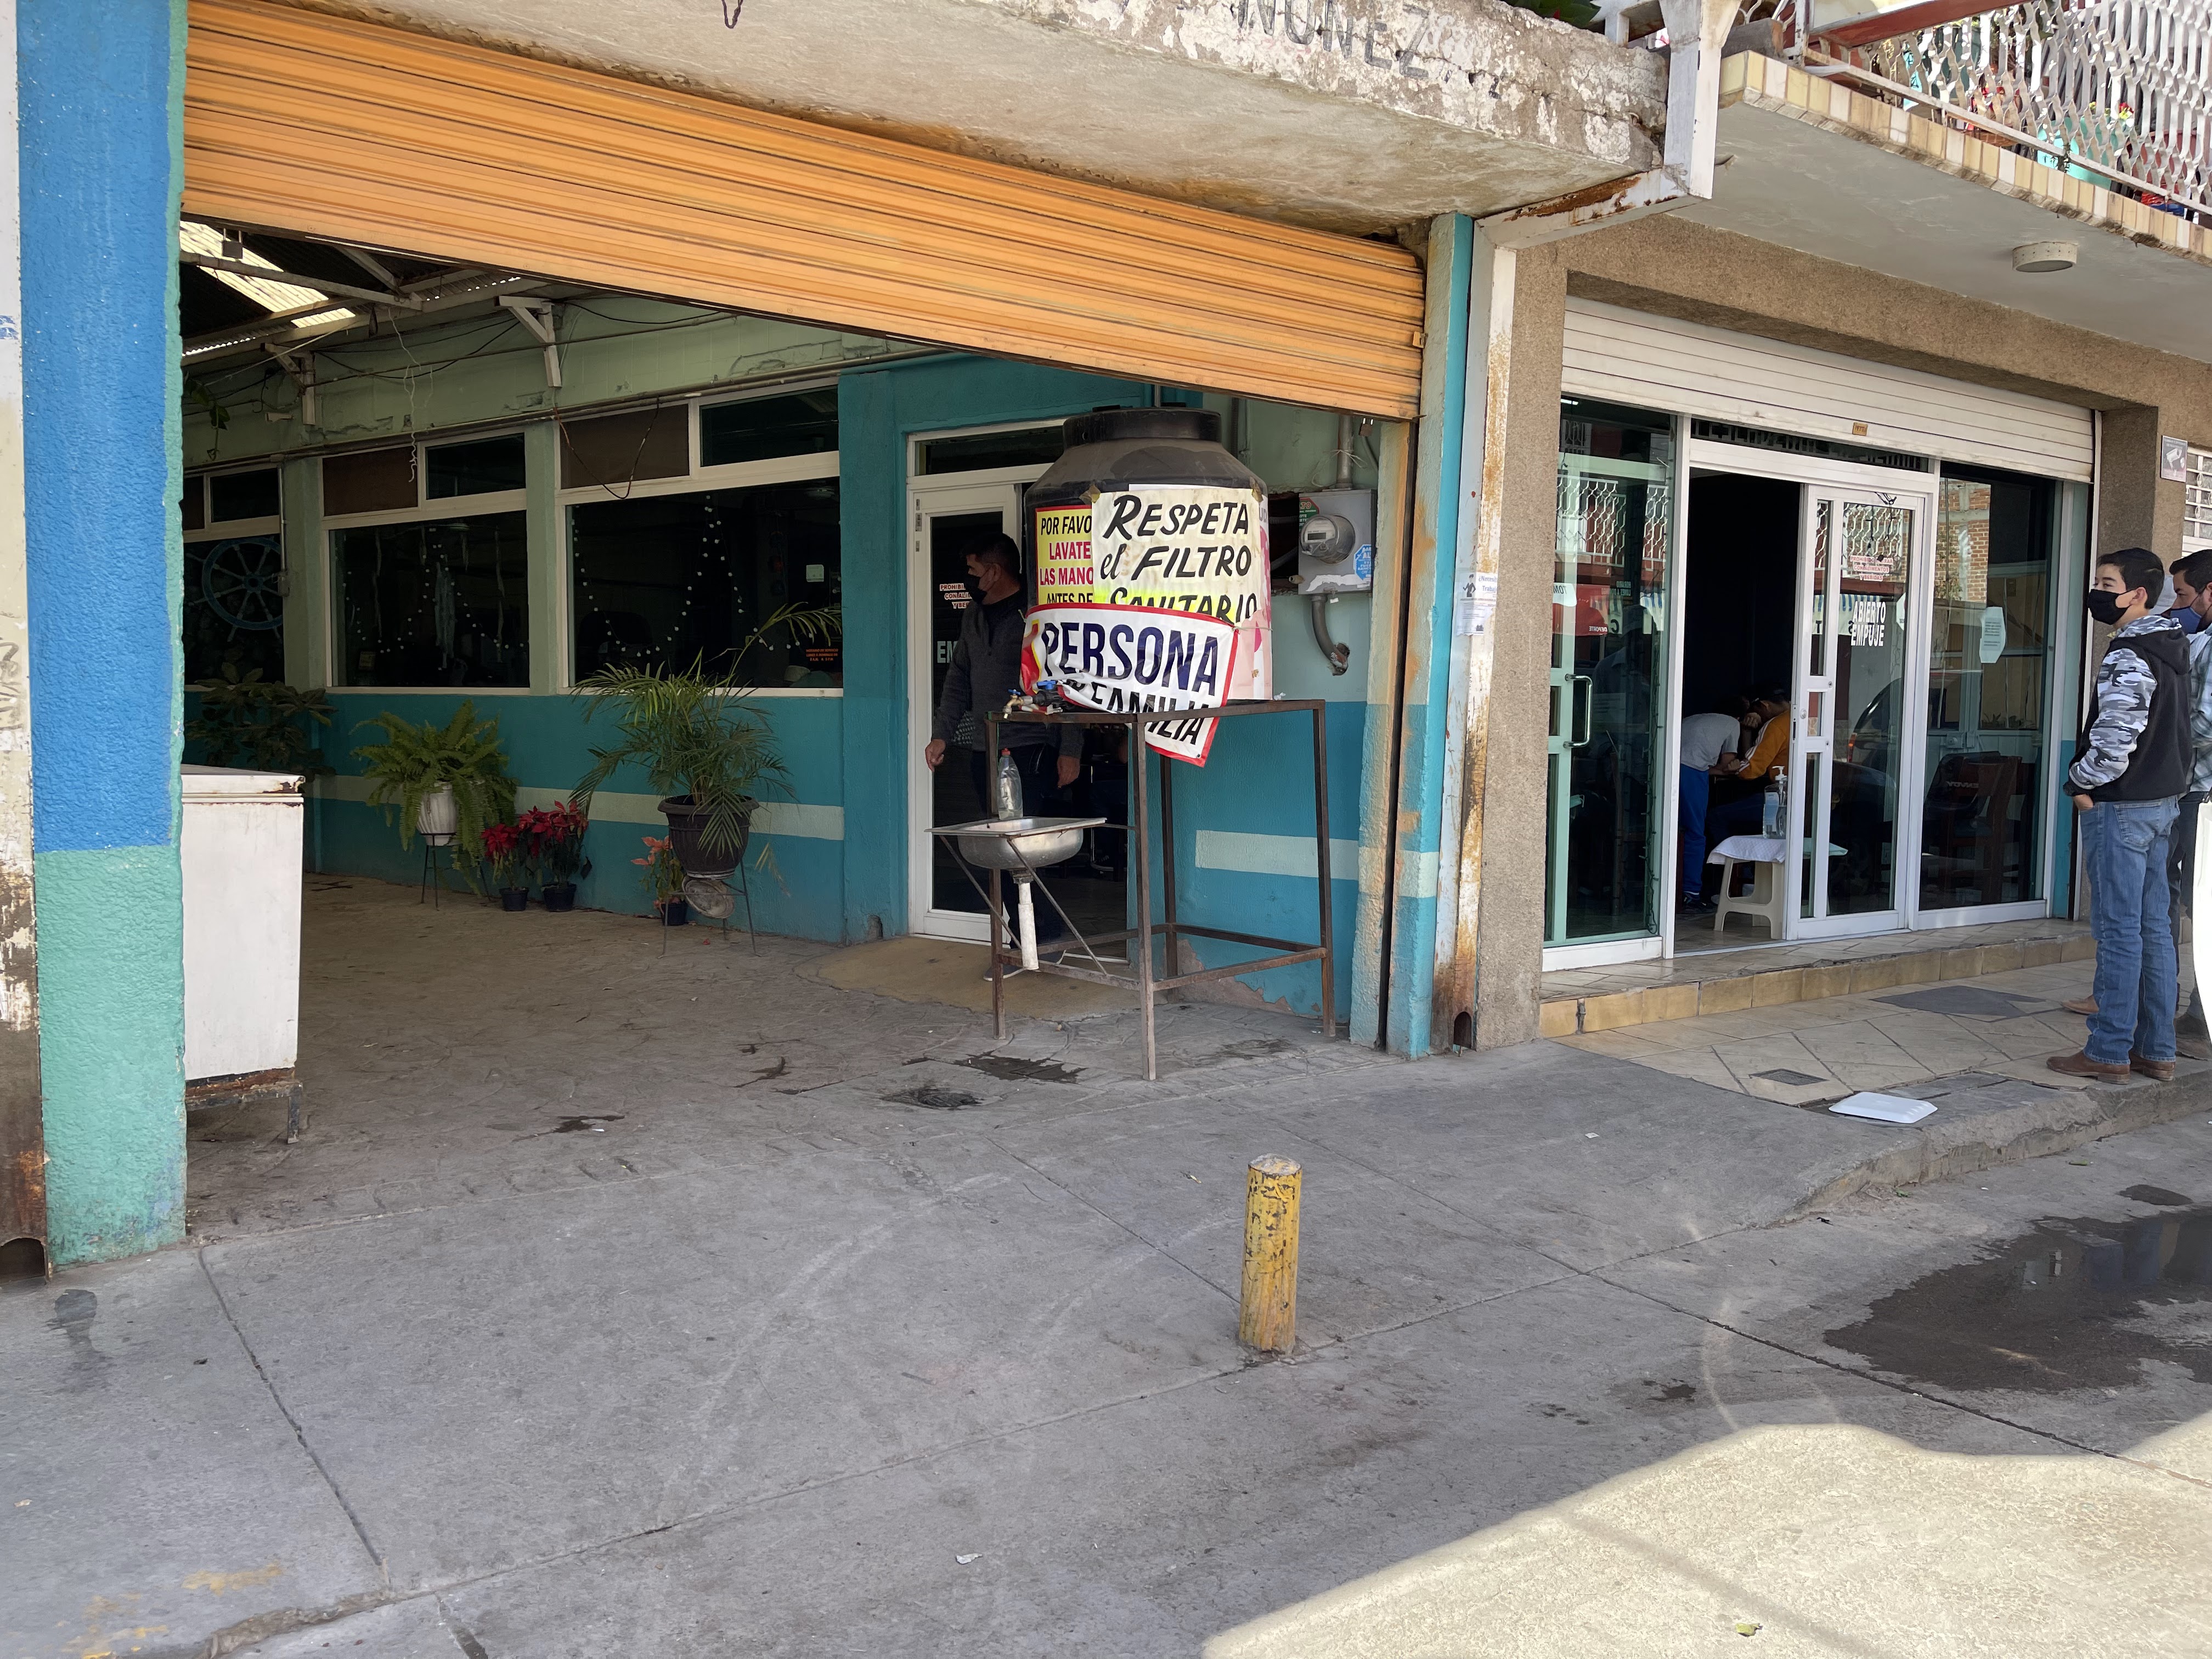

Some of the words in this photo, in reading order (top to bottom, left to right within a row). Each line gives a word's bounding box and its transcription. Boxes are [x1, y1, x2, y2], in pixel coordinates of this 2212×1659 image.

[1041, 516, 1059, 535] POR
[1103, 495, 1248, 540] RESPETA
[1049, 541, 1091, 560] LAVATE
[1101, 543, 1127, 579] el
[1131, 545, 1252, 580] FILTRO
[1040, 568, 1056, 585] LAS
[1853, 601, 1886, 624] ABIERTO
[1851, 624, 1886, 647] EMPUJE
[1042, 622, 1218, 696] PERSONA
